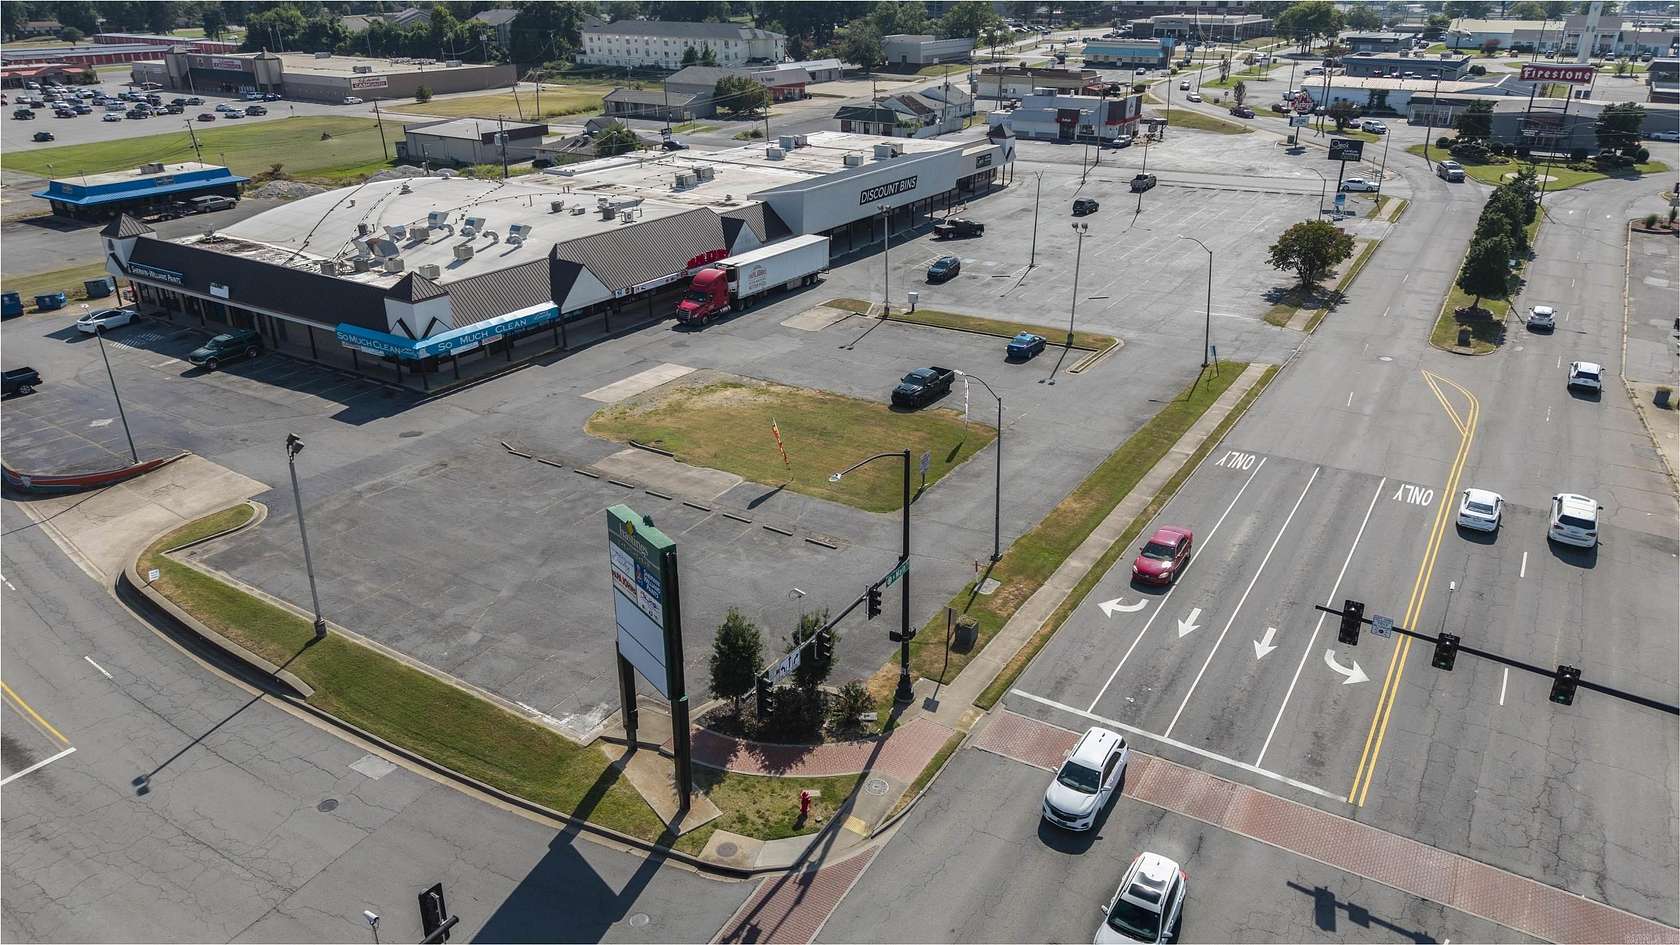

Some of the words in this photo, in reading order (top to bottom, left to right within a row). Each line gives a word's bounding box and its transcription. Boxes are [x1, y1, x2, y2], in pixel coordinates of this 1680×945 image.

[1522, 66, 1591, 80] Firestone
[861, 182, 900, 203] DISCOUNT
[900, 177, 917, 192] BINS
[337, 331, 349, 341] SO
[349, 335, 372, 349] MUCH
[374, 341, 401, 354] CLEAN
[438, 341, 453, 351] SO
[459, 331, 489, 346] MUCH
[495, 319, 528, 334] CLEAN
[1216, 450, 1256, 470] ONLY
[1393, 483, 1434, 506] ONLY
